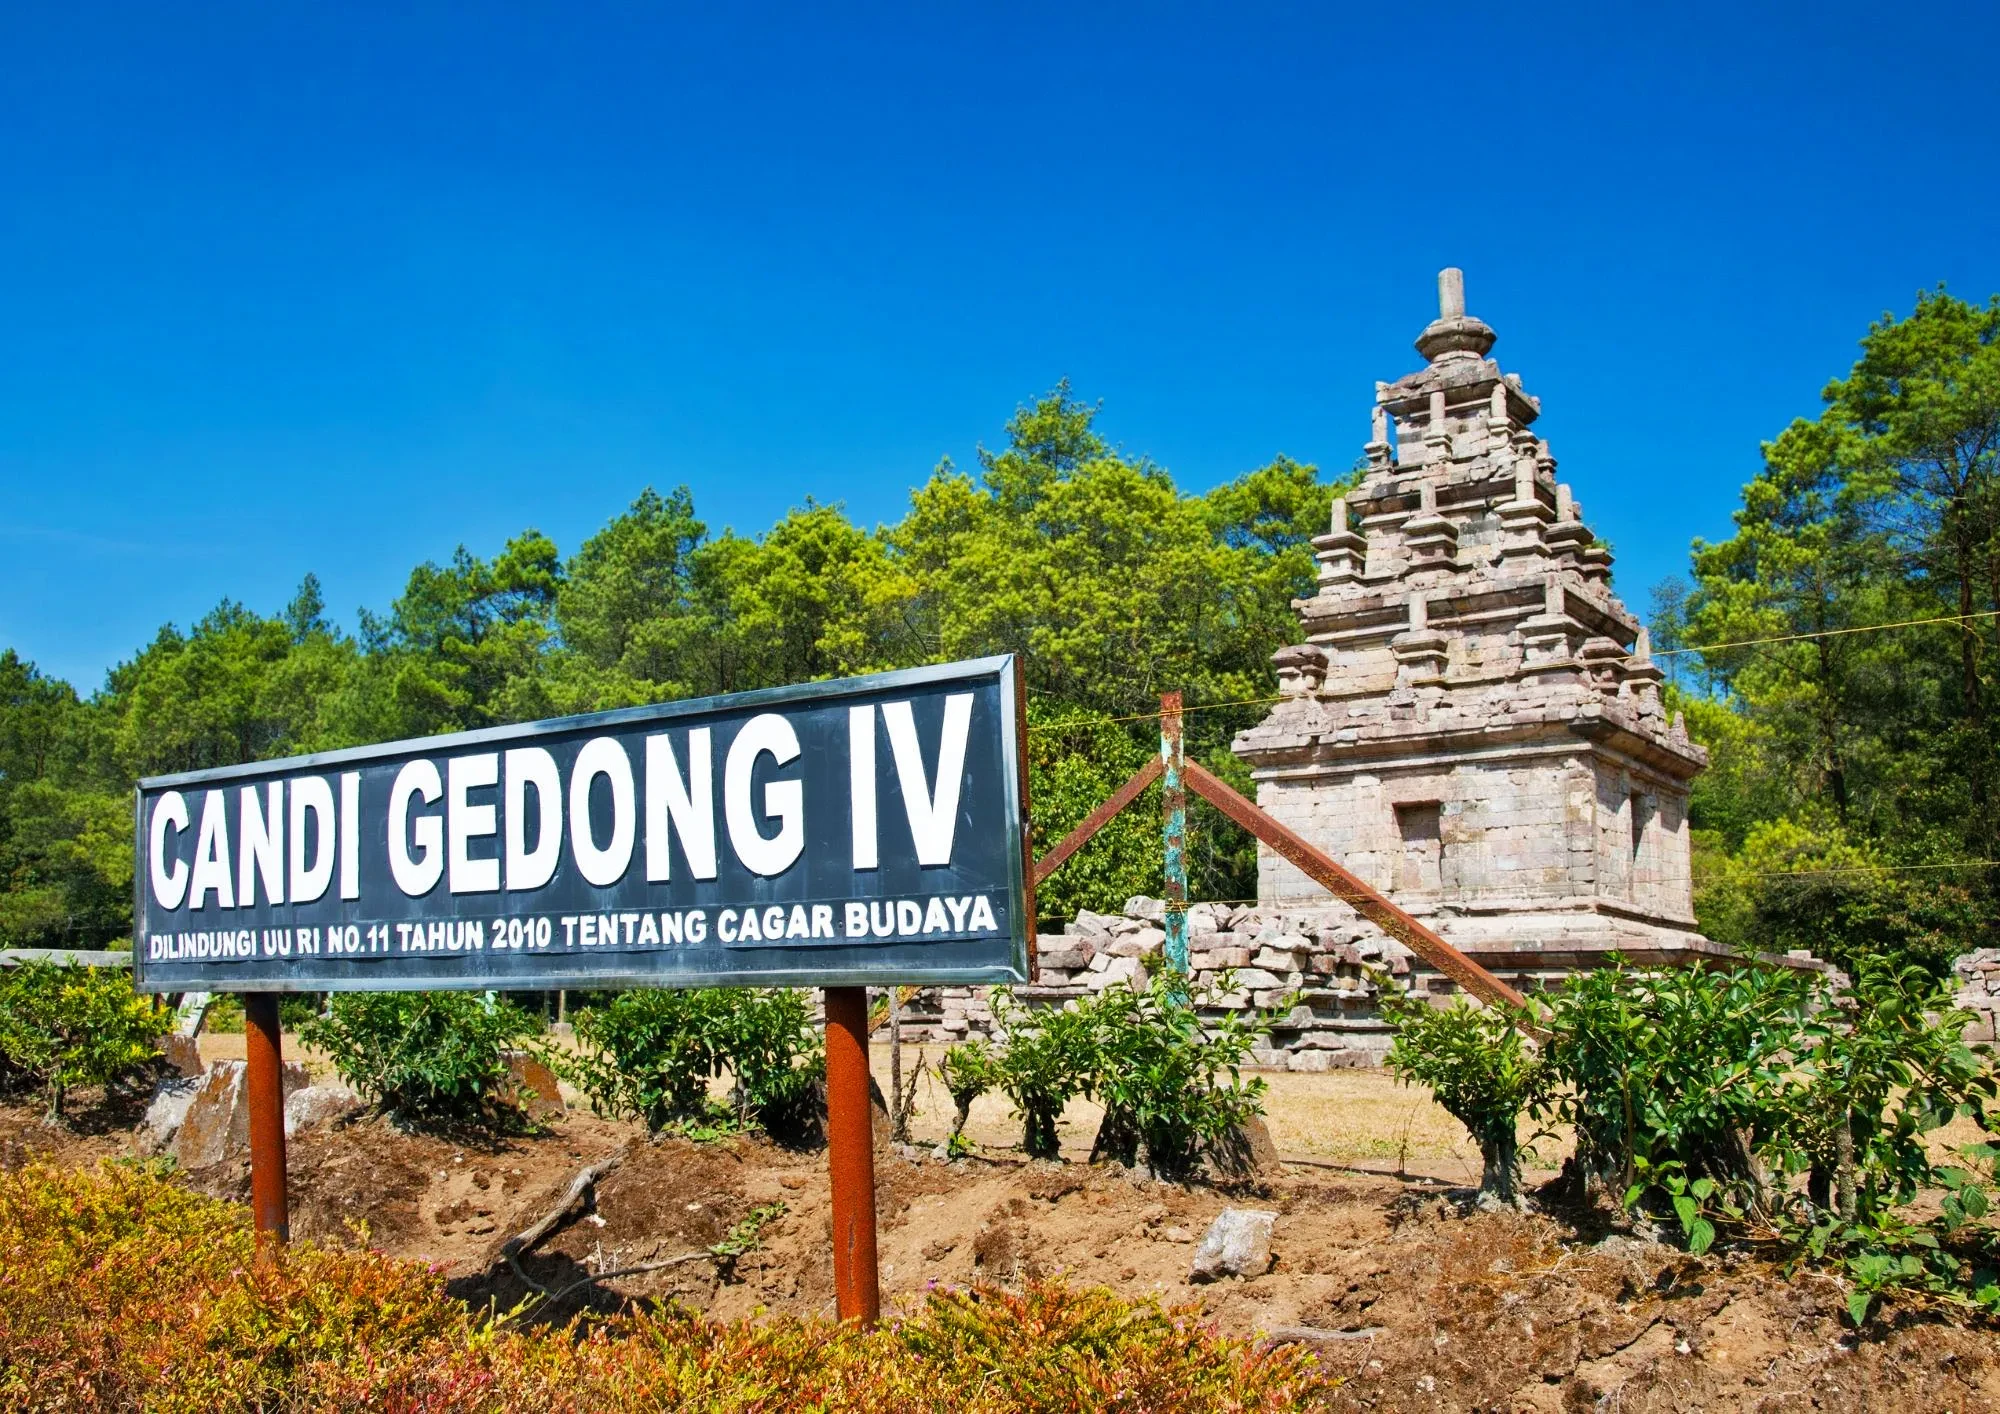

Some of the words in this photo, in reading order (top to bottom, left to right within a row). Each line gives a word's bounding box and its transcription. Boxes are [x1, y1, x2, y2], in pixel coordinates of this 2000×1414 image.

[150, 771, 361, 910] CANDI
[388, 713, 805, 896] GEDONG
[849, 692, 975, 869] IV
[150, 928, 257, 959] DILINDUNGI
[263, 929, 292, 956] UU
[297, 927, 320, 955] RI
[328, 925, 389, 954] NO.11
[396, 920, 484, 951] TAHUN
[491, 916, 552, 949] 2010
[561, 911, 707, 947] TENTANG
[717, 902, 835, 943] CAGAR
[844, 895, 998, 938] BUDAYA
